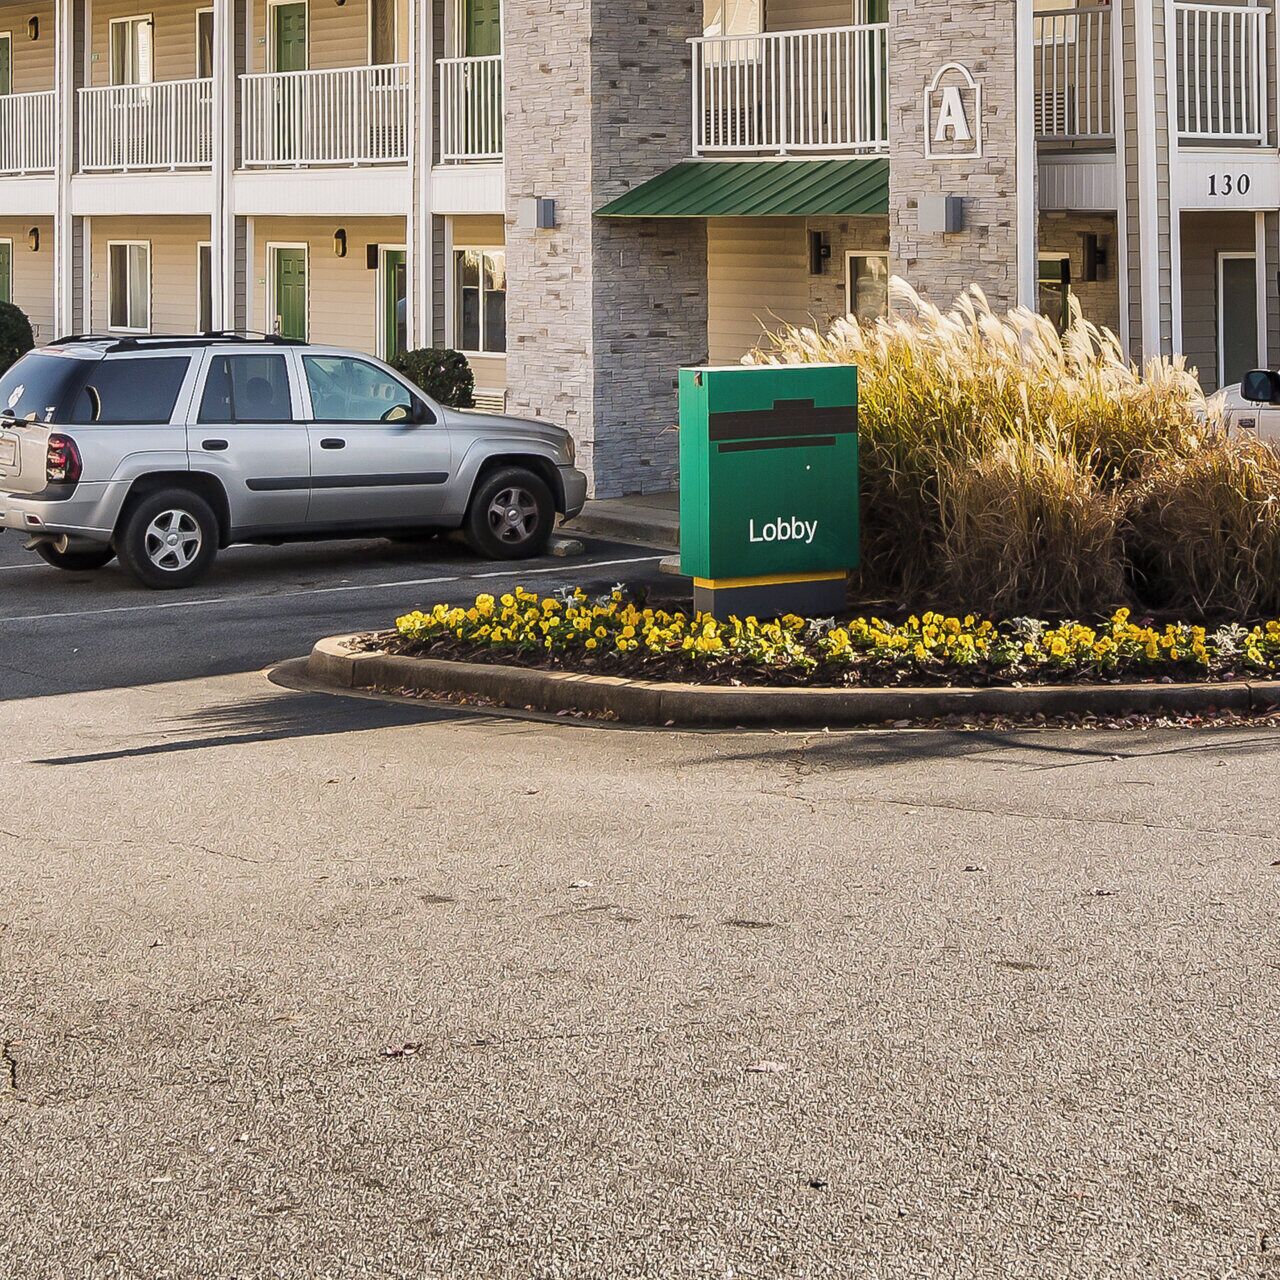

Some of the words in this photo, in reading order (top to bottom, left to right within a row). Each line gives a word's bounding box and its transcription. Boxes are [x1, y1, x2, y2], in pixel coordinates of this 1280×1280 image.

[934, 86, 972, 141] A
[1208, 173, 1250, 196] 130
[749, 516, 818, 544] Lobby
